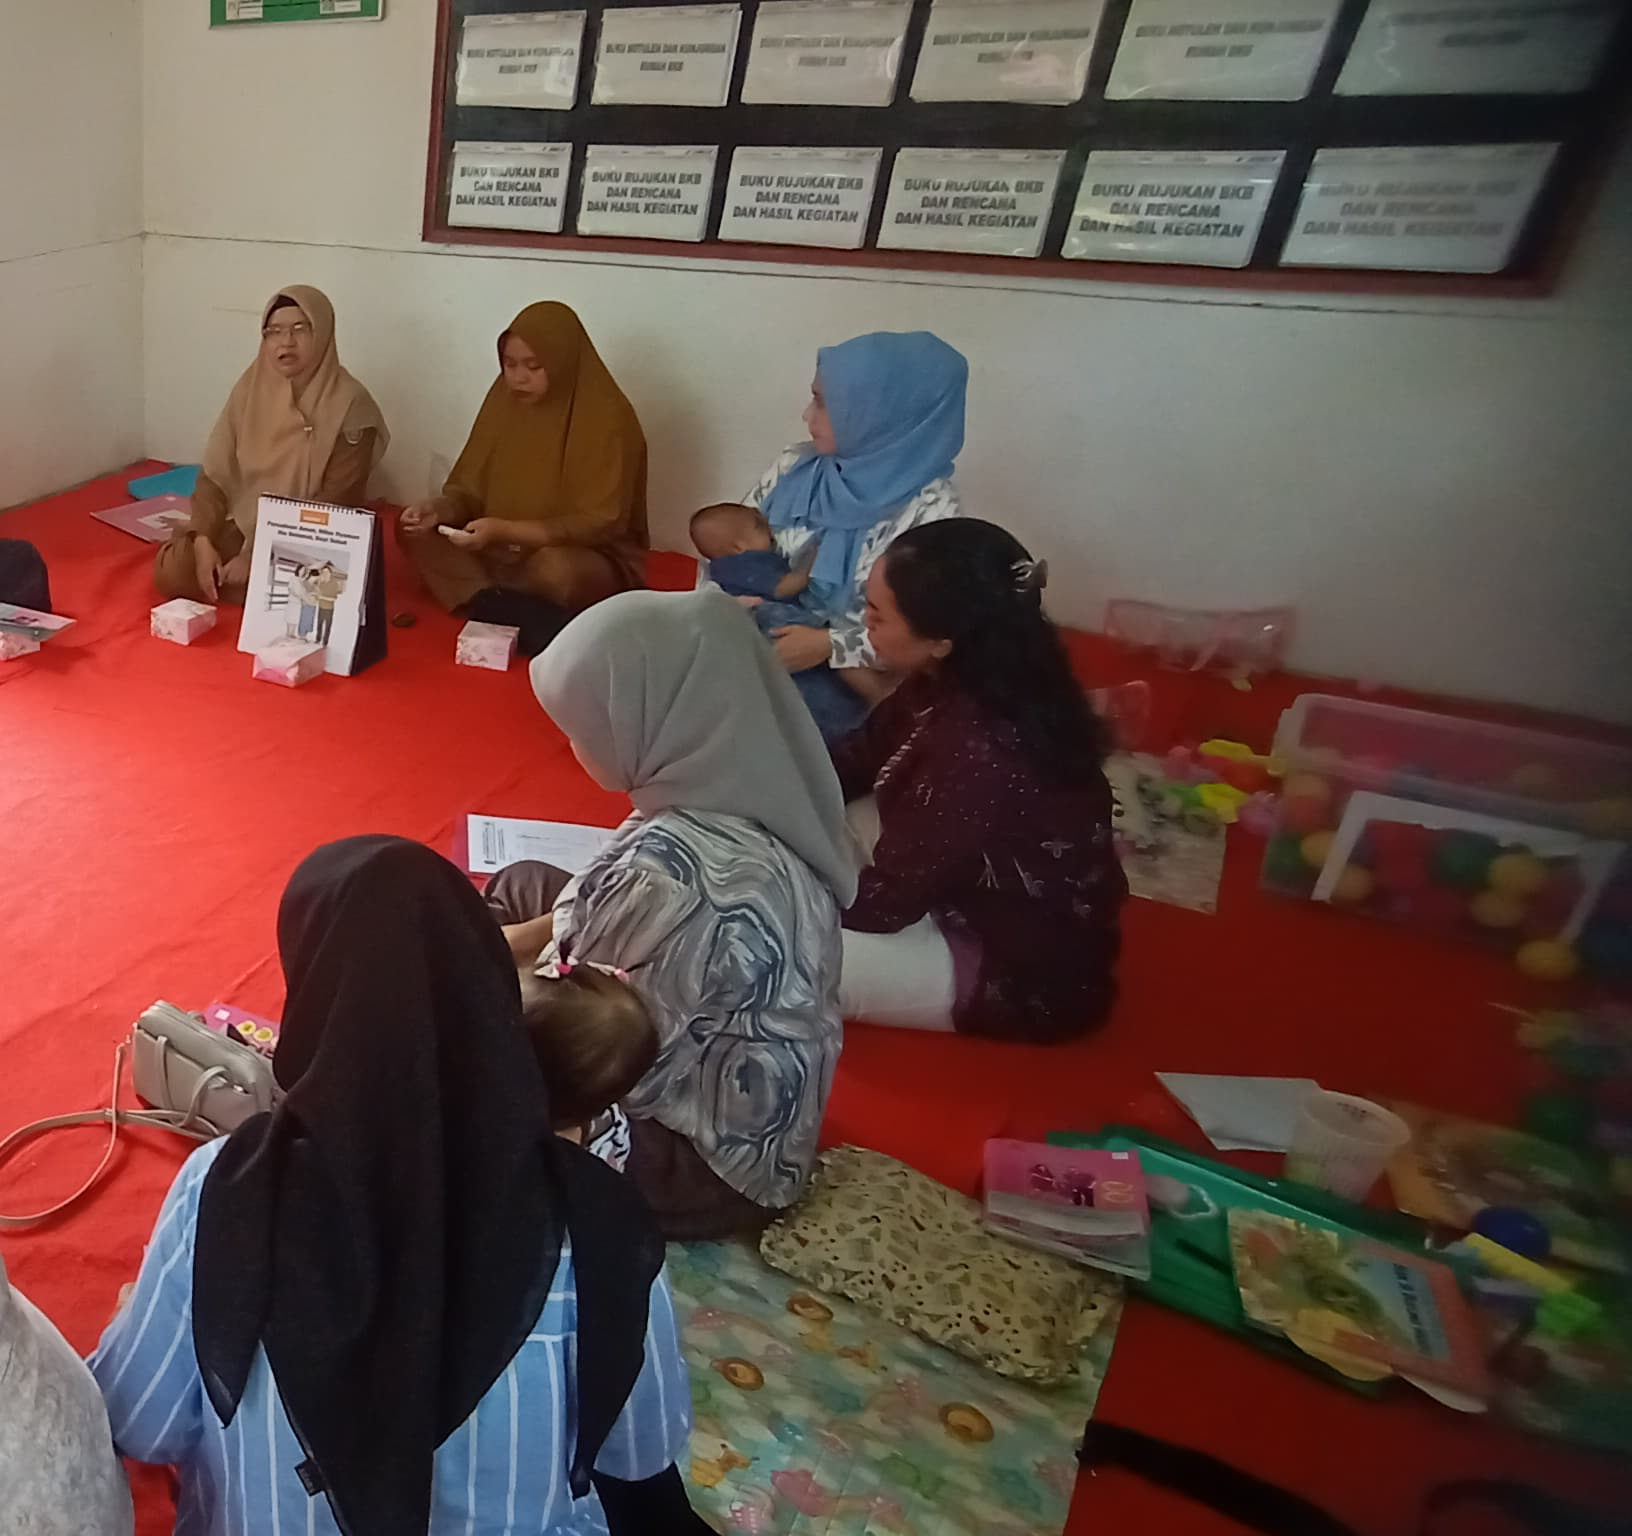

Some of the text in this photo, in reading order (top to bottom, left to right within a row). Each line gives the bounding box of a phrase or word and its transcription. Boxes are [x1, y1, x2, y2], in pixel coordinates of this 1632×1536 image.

[460, 166, 487, 177] BUKU
[538, 167, 560, 178] BKB
[592, 171, 702, 184] BUKU RUJUKAN BKB
[495, 181, 541, 192] RENCANA
[739, 174, 864, 190] BUKU RUJUKAN BKB
[904, 178, 1044, 193] BUKU RUJUKAN BKB
[606, 186, 681, 199] DAN RENCANA
[755, 191, 840, 205] DAN RENCANA
[1091, 184, 1255, 200] BUKU RUJUKAN BKB
[456, 195, 557, 207] DAN HASIL KEGIATAN
[586, 200, 698, 215] DAN HASIL KEGIATAN
[921, 196, 1016, 210] DAN RENCANA
[733, 206, 859, 223] DAN HASIL KEGIATAN
[1109, 202, 1221, 218] DAN RENCANA
[895, 212, 1038, 228] DAN HASIL KEGIATAN
[1079, 217, 1109, 232] DAN
[1162, 223, 1245, 237] KEGIATAN
